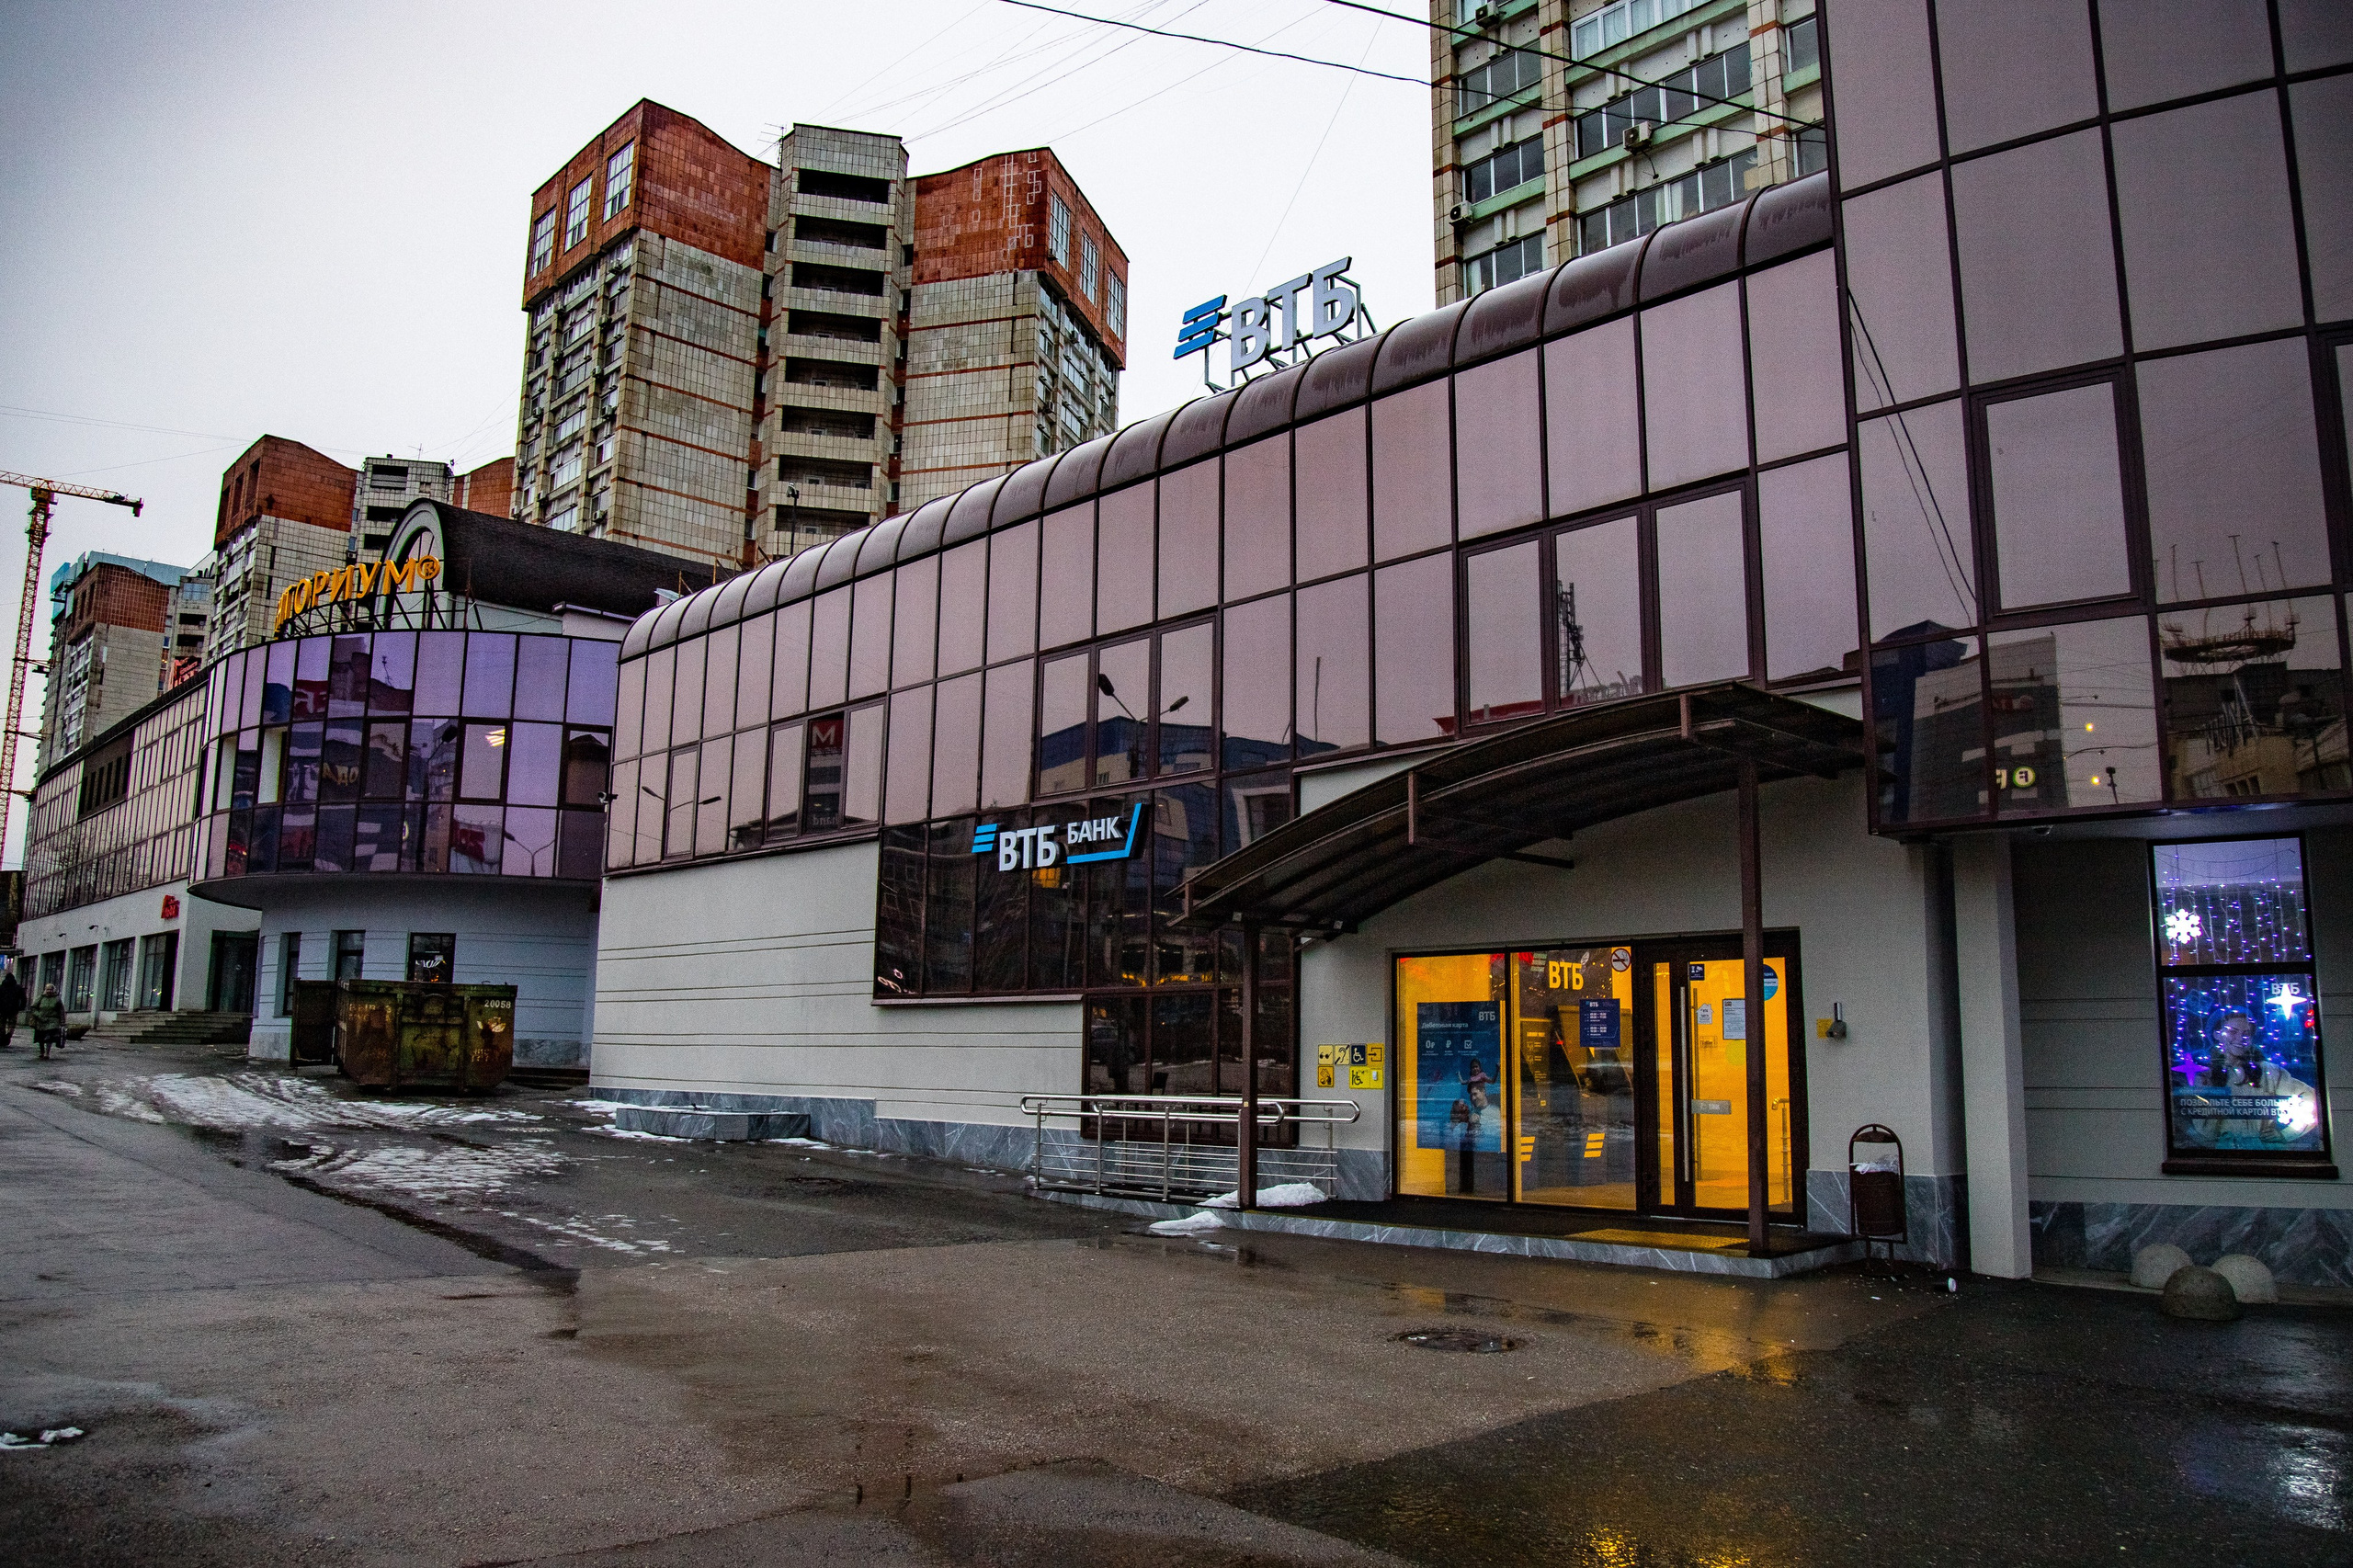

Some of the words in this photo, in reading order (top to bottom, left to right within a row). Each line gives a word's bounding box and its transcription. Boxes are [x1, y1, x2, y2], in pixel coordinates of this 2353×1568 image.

[1231, 256, 1356, 372] ВТБ
[999, 825, 1057, 871] ВТБ
[1067, 816, 1122, 844] БАНК
[1549, 960, 1584, 990] ВТБ
[484, 999, 512, 1009] 20058
[1478, 1011, 1495, 1021] ВТБ
[2232, 1097, 2253, 1107] СЕБЕ
[2188, 1106, 2235, 1117] КРЕДИТНОЙ
[2236, 1106, 2269, 1116] КАРТОЙ
